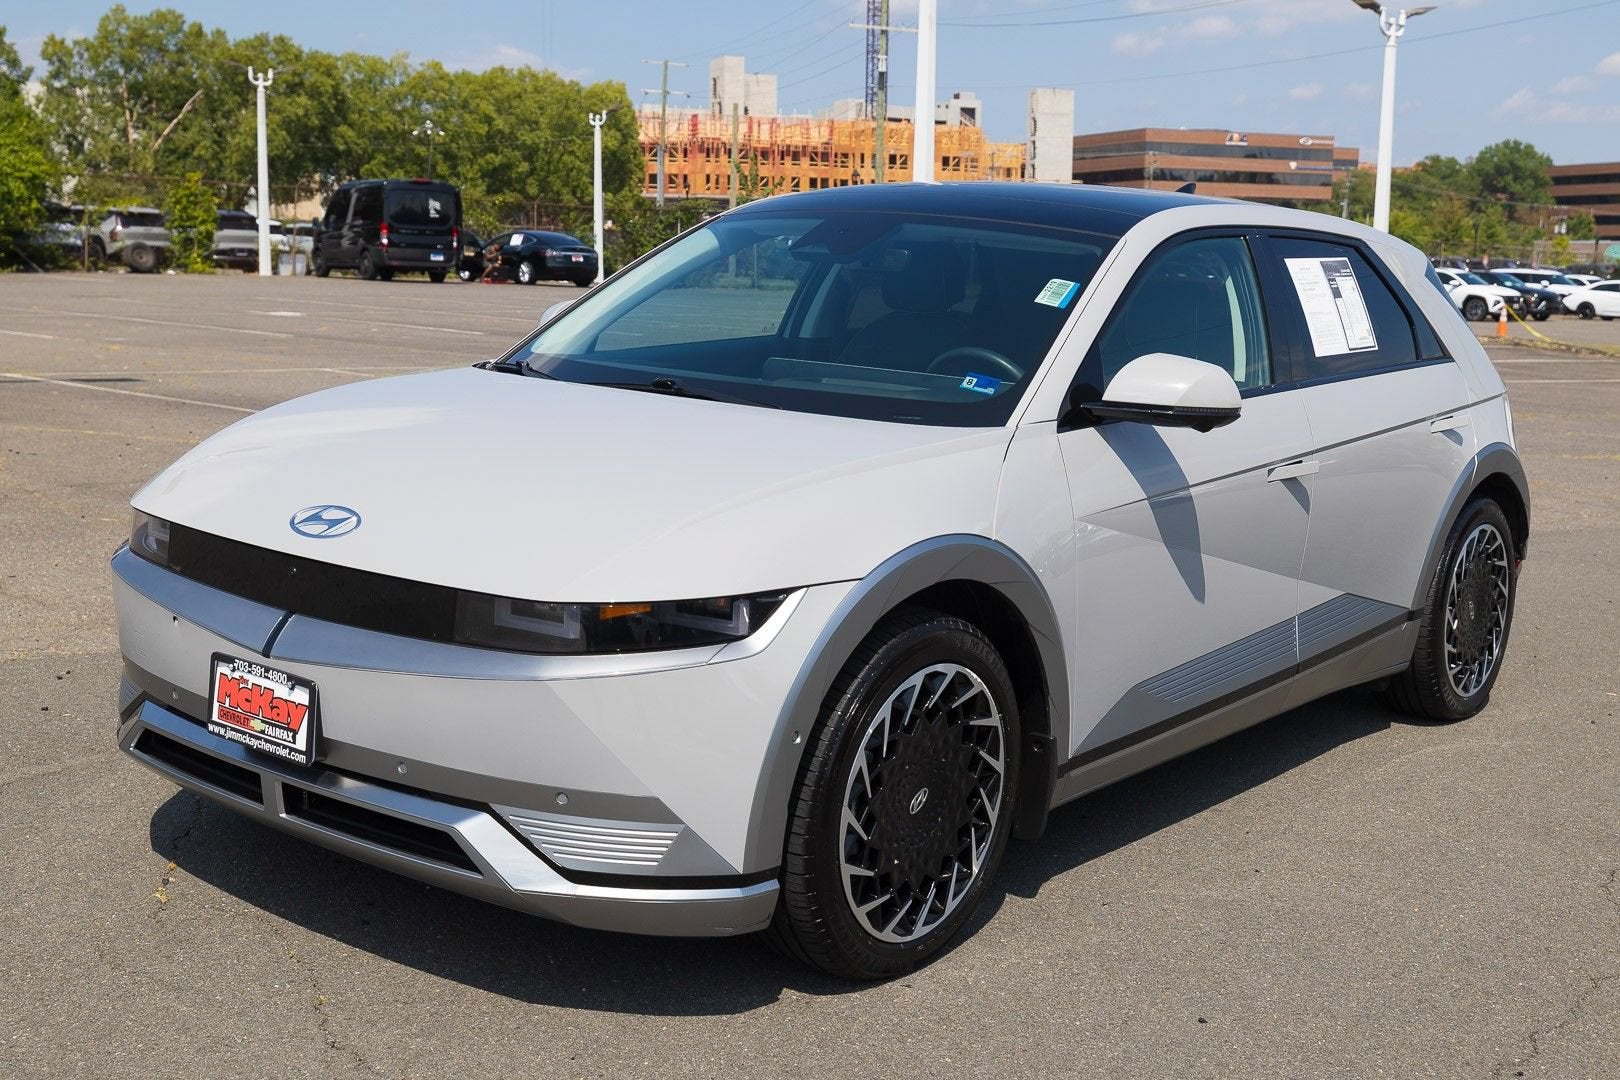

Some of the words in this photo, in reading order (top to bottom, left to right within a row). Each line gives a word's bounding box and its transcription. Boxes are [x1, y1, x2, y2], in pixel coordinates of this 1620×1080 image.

[966, 378, 974, 386] 8
[234, 659, 288, 685] 703-591-4800
[217, 671, 309, 734] McKay
[219, 708, 250, 728] CHEVROLET
[265, 724, 294, 743] FAIRFAX
[207, 723, 307, 764] www.jimmckaychevrolet.com
